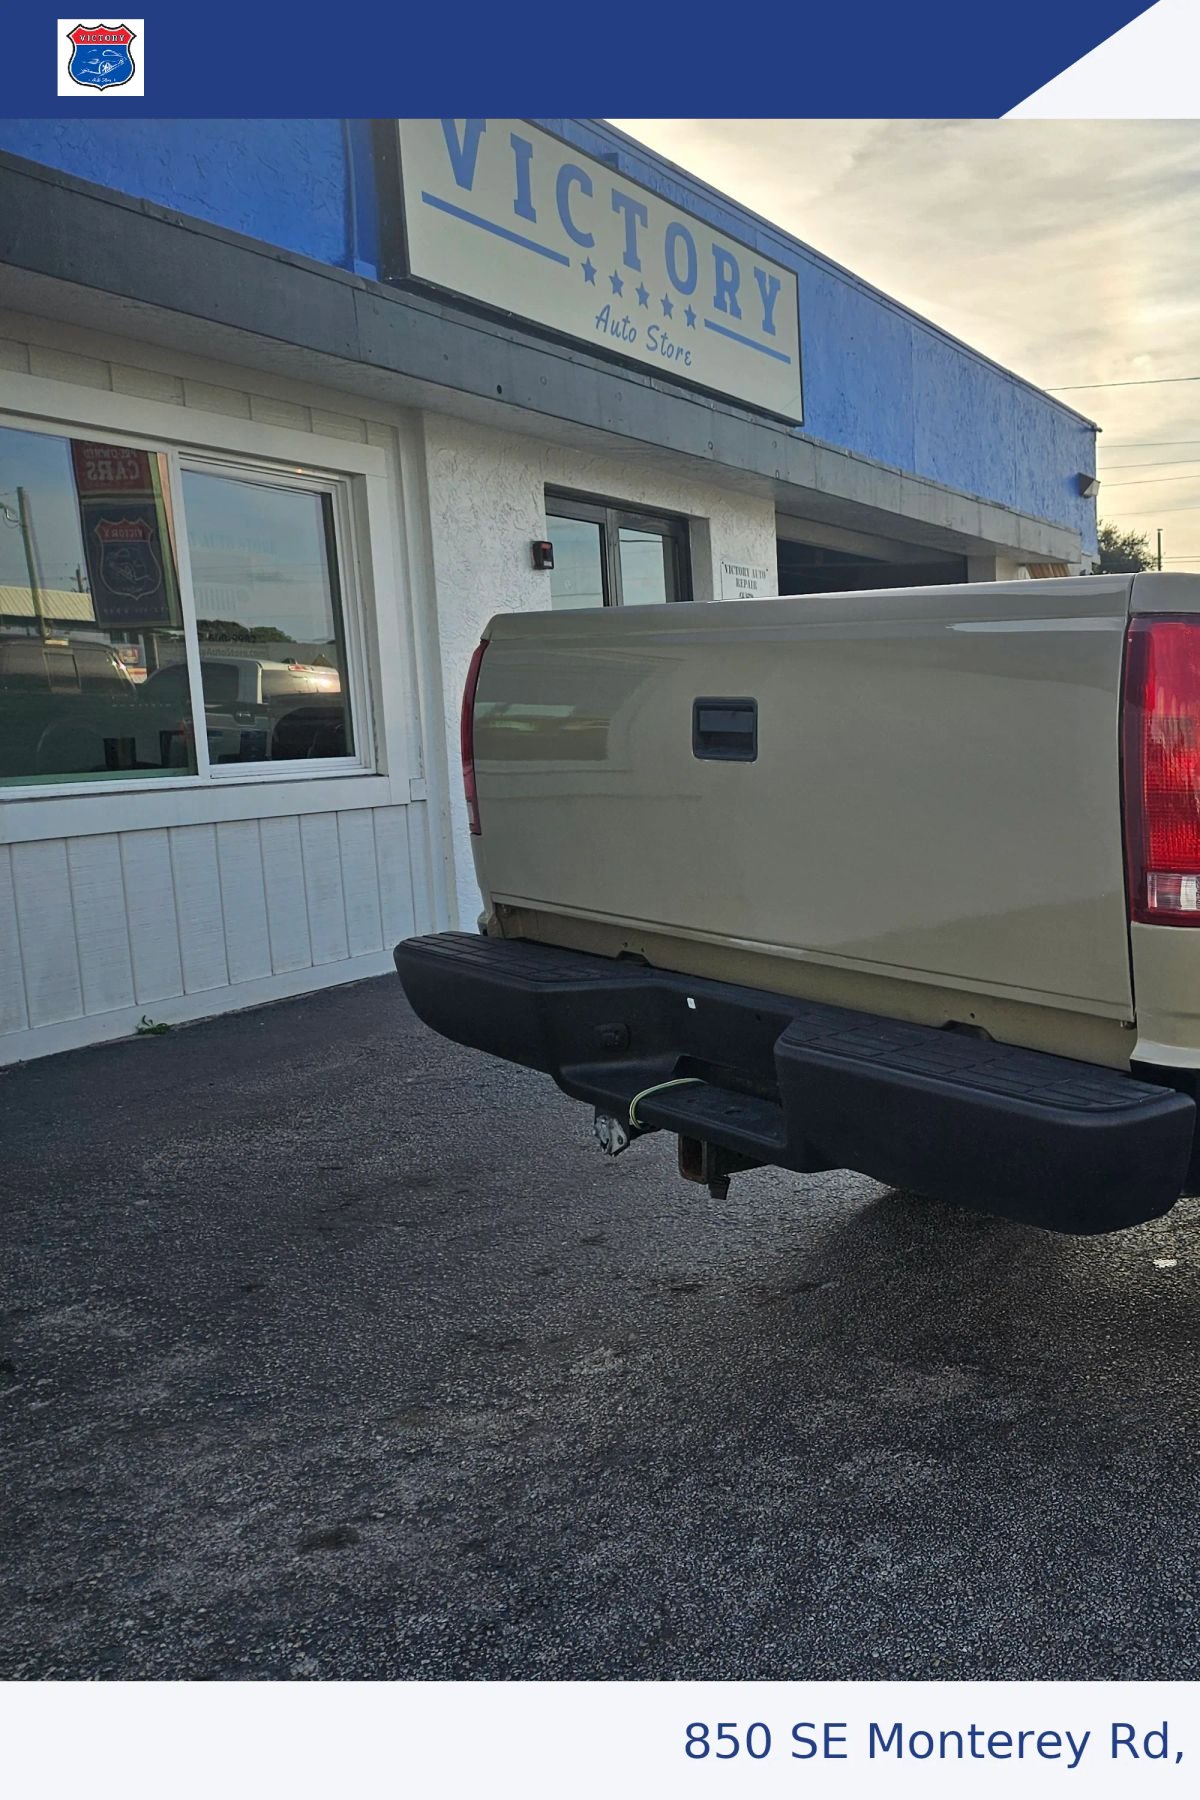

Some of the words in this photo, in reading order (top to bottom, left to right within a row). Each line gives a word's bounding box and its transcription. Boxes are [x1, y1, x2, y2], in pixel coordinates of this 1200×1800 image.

[440, 118, 782, 336] VICTORY
[595, 304, 638, 344] Auto
[646, 325, 693, 367] Store
[724, 563, 750, 578] VICTORY
[736, 578, 758, 590] REPAIR
